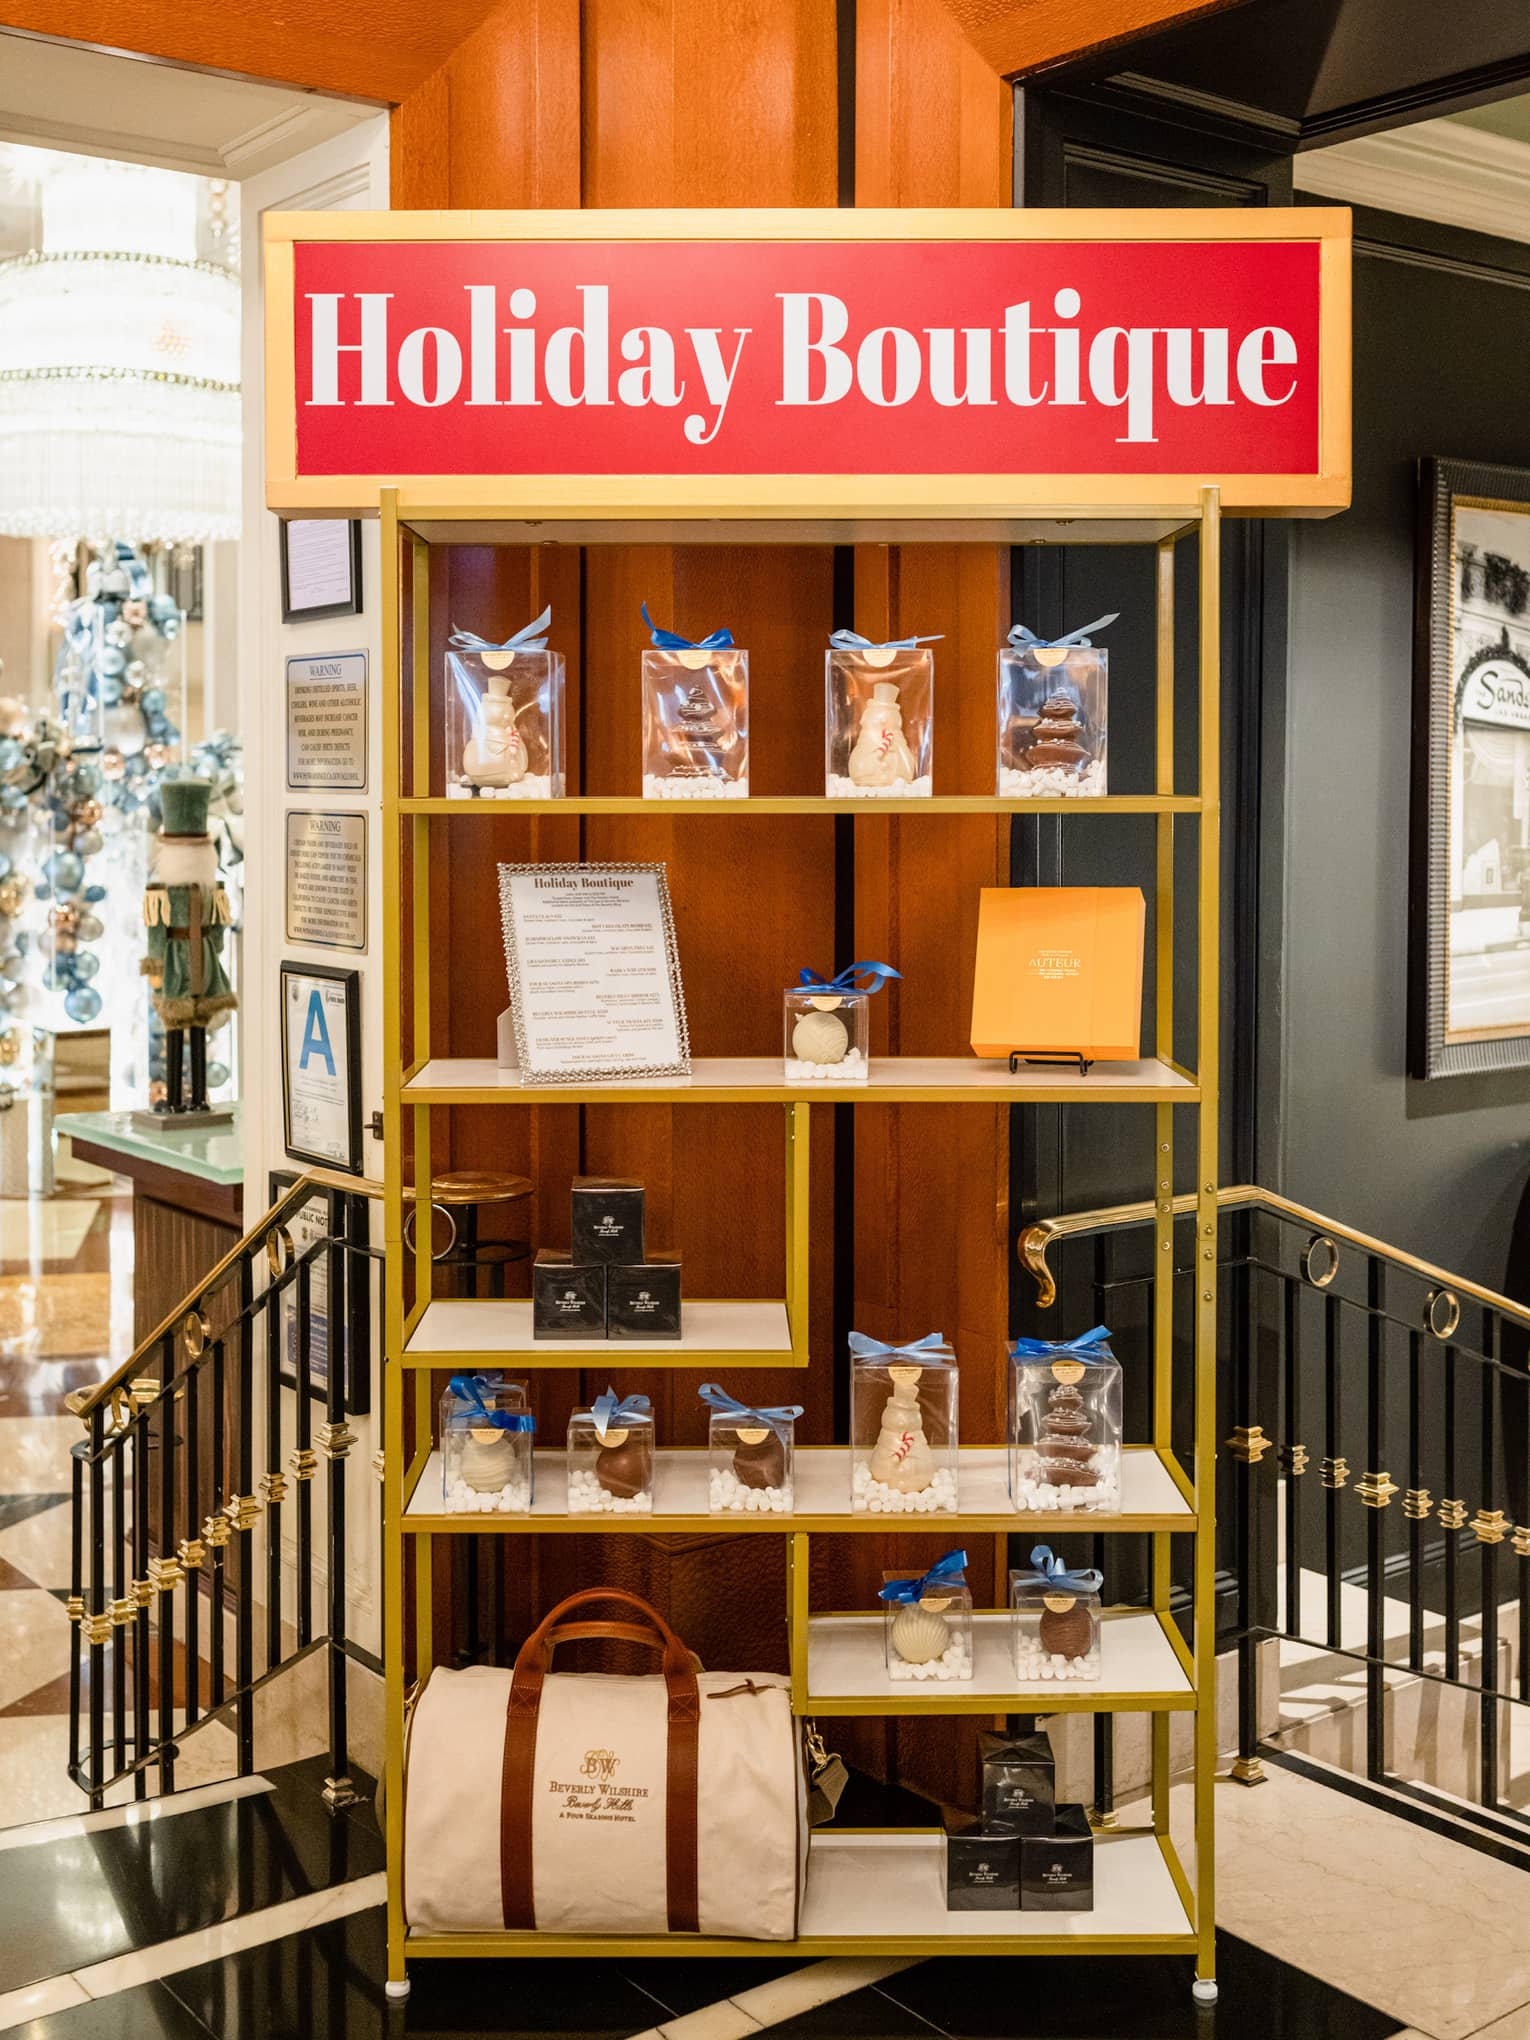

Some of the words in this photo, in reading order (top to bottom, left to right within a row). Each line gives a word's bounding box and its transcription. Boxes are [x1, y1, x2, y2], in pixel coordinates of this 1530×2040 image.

[305, 285, 753, 445] Holiday
[776, 287, 1298, 444] Boutique
[310, 664, 342, 676] WARNING
[310, 820, 341, 832] WARNING
[534, 877, 577, 891] Holiday
[581, 877, 634, 891] Boutique
[1028, 958, 1081, 968] AUTEUR
[299, 990, 337, 1077] A
[315, 1215, 328, 1227] NOT
[549, 1781, 596, 1794] BEVERLY
[598, 1784, 649, 1798] WILSHIRE
[562, 1795, 602, 1813] Beverly
[603, 1797, 634, 1811] Hills
